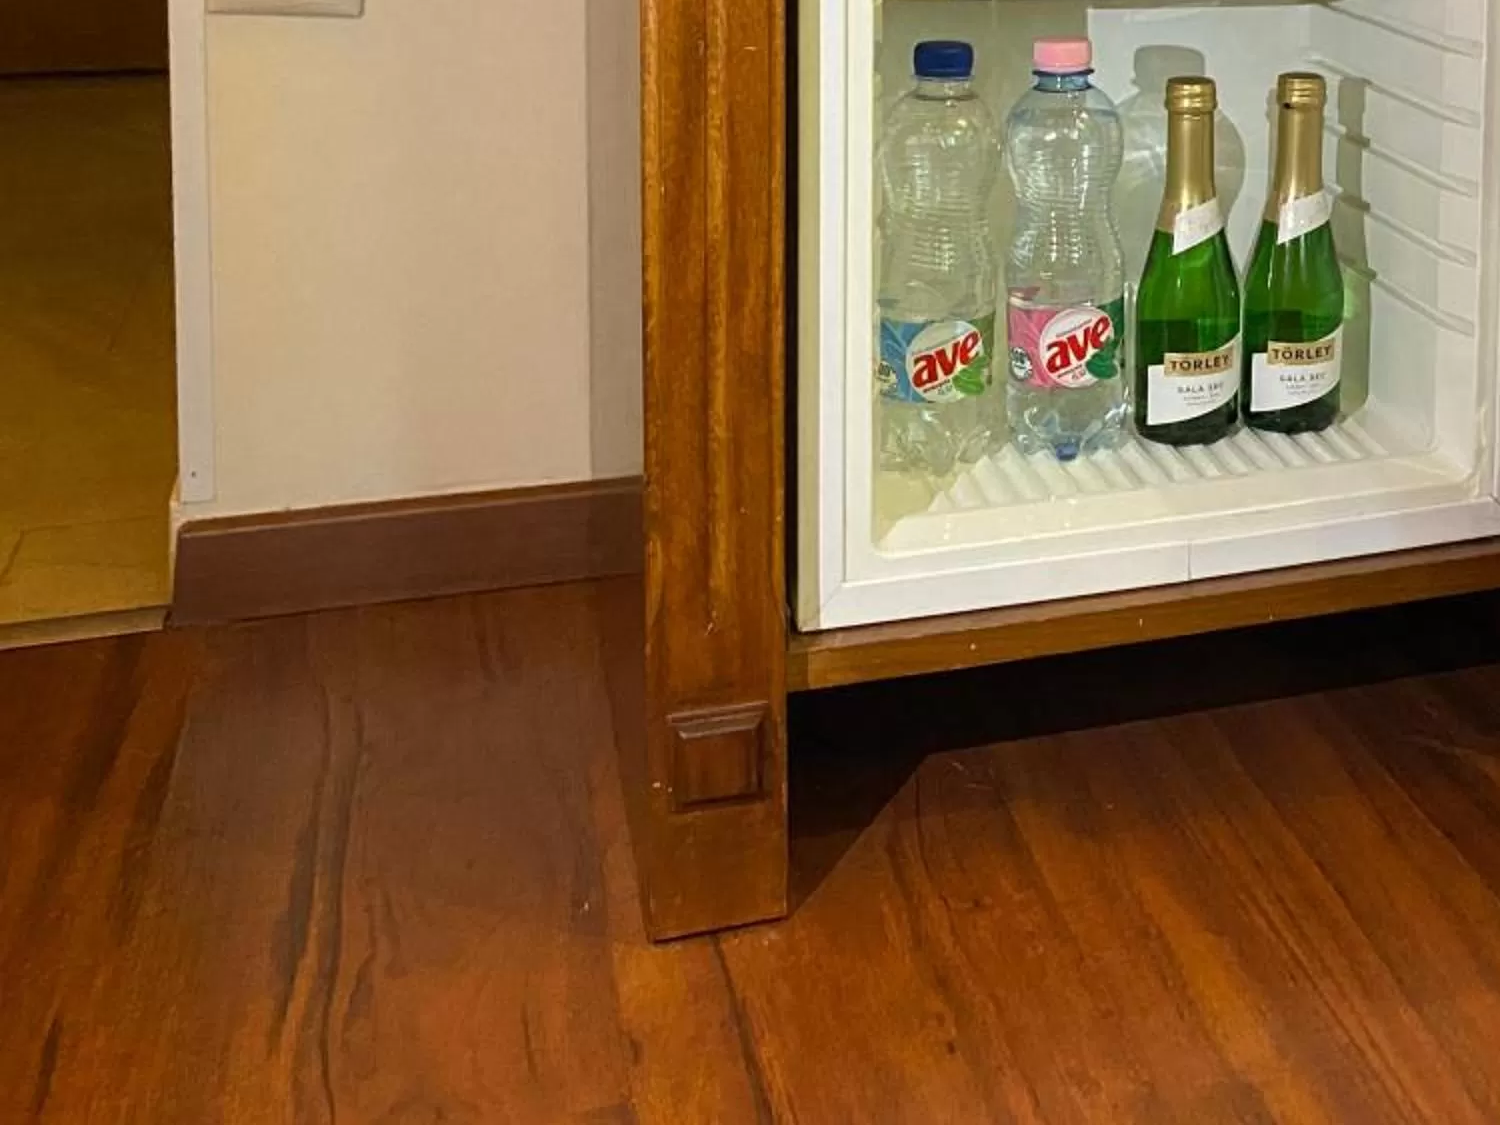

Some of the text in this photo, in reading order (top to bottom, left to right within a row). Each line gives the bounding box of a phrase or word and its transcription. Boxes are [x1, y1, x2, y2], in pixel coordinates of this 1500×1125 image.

[911, 330, 981, 388] ave
[1045, 315, 1111, 374] ave
[1271, 344, 1332, 360] TÖRLEY
